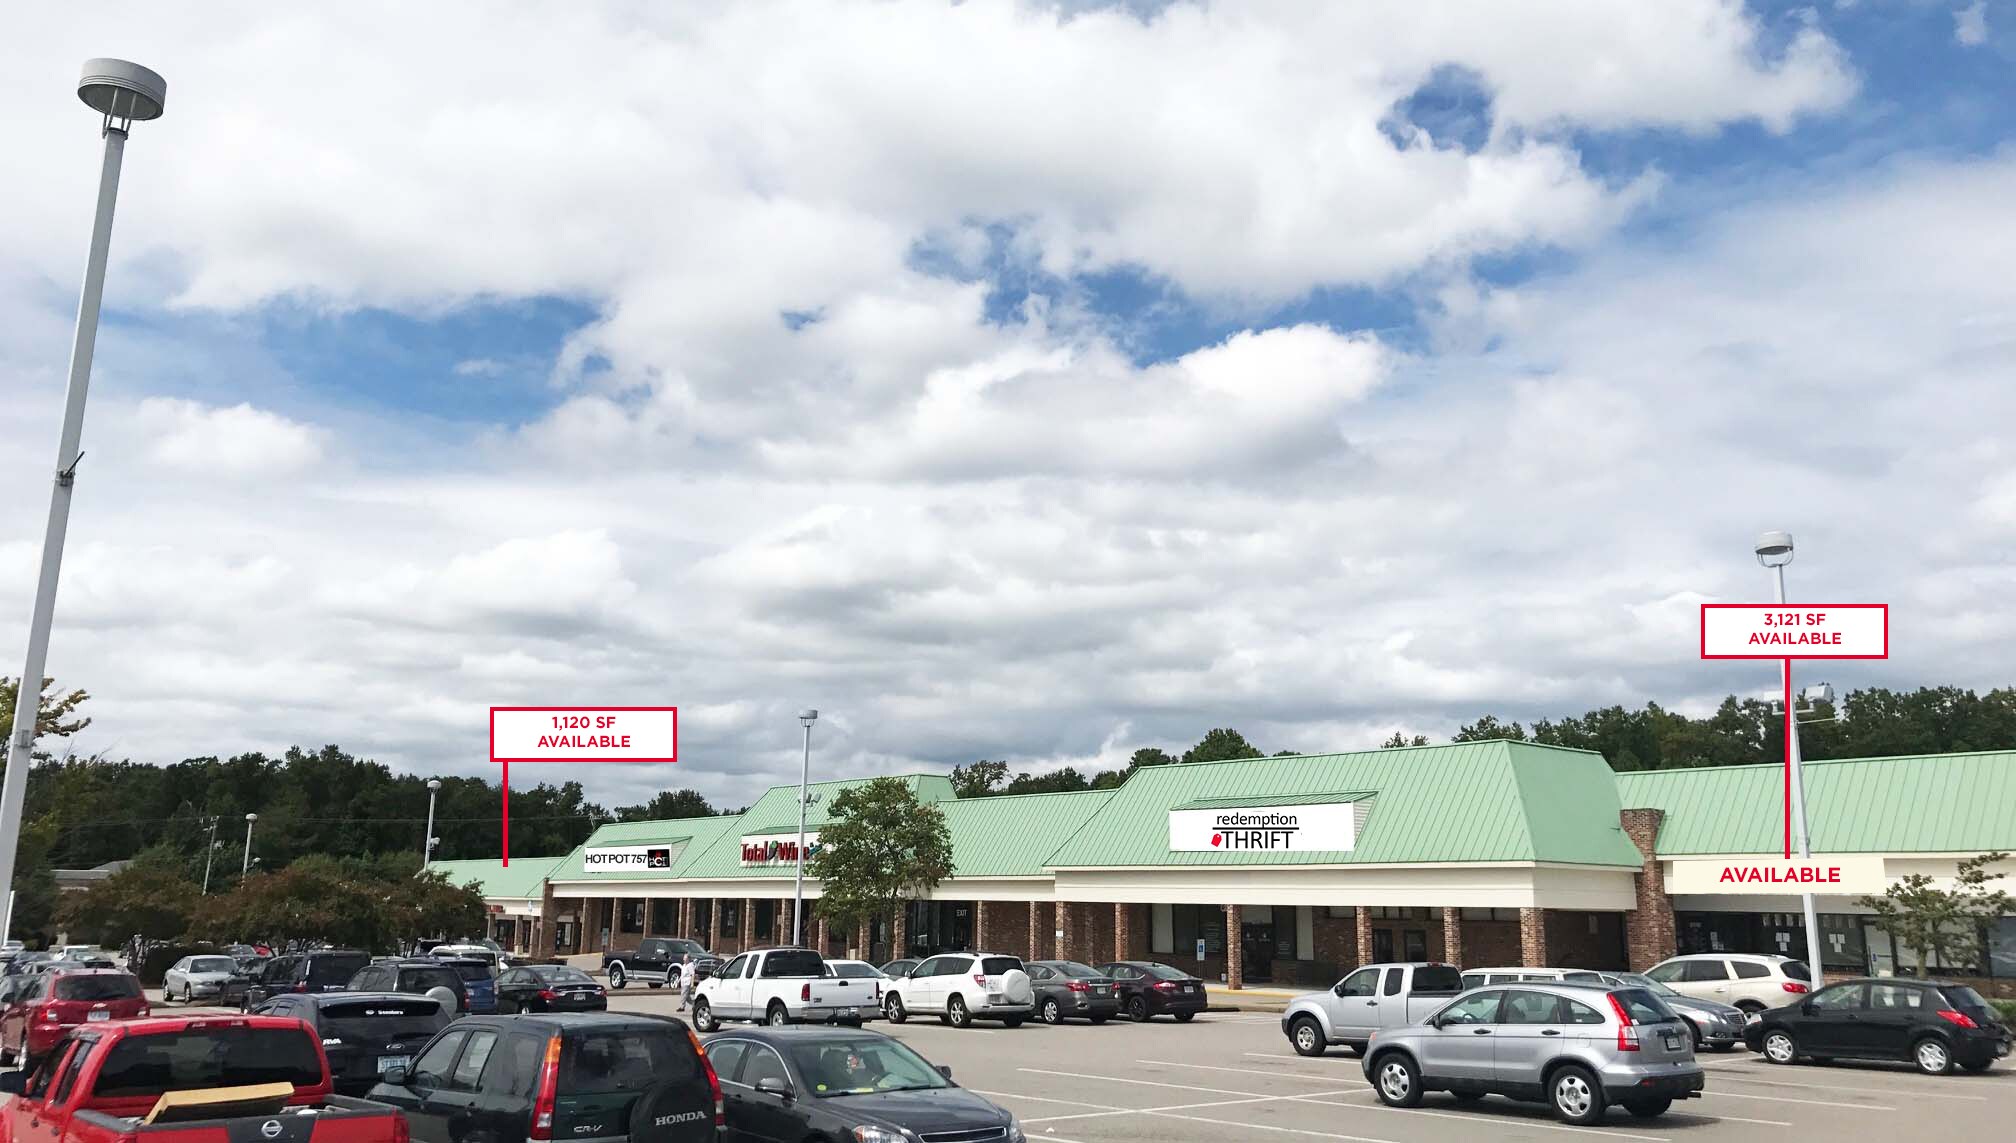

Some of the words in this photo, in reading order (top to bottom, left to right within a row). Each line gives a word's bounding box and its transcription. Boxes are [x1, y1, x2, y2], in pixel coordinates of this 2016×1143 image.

[1216, 811, 1297, 828] redemption
[1221, 831, 1294, 849] THRIFT
[585, 854, 608, 864] HOT
[608, 854, 631, 864] POT
[631, 854, 648, 864] 757
[741, 841, 768, 862] Total
[956, 909, 968, 917] EXIT
[655, 1110, 707, 1126] HONDA
[573, 1124, 603, 1133] CR-V
